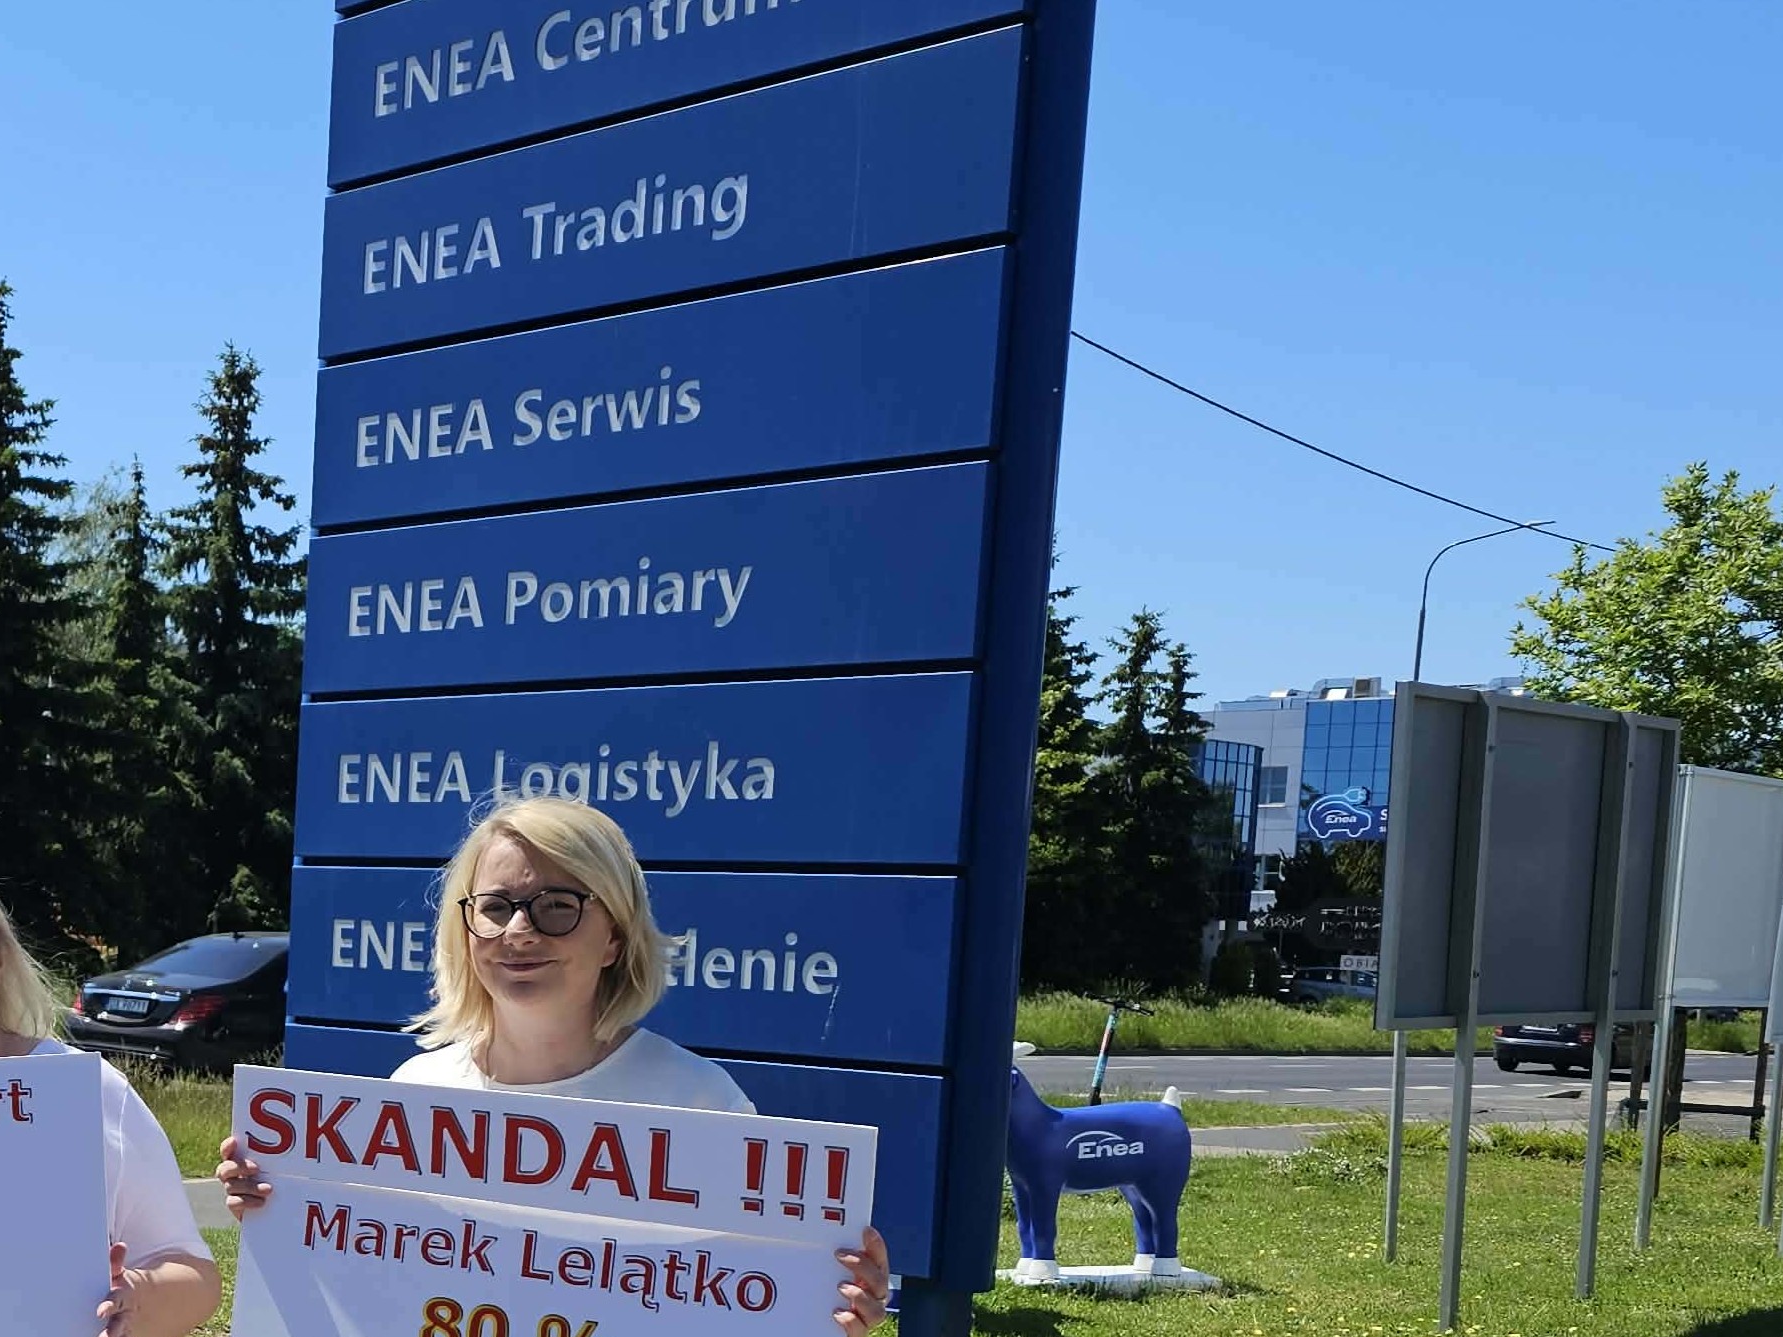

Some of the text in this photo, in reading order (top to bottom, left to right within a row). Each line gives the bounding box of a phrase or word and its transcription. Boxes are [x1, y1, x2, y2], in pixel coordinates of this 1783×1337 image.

[376, 32, 514, 116] ENEA
[365, 176, 747, 293] ENEA Trading
[357, 368, 700, 467] ENEA Serwis
[349, 558, 750, 636] ENEA Pomiary
[339, 739, 776, 819] ENEA Logistyka
[333, 920, 433, 972] ENE
[244, 1088, 849, 1226] SKANDAL !!!
[1078, 1141, 1144, 1159] Enea
[304, 1201, 778, 1313] Marek Lelątko
